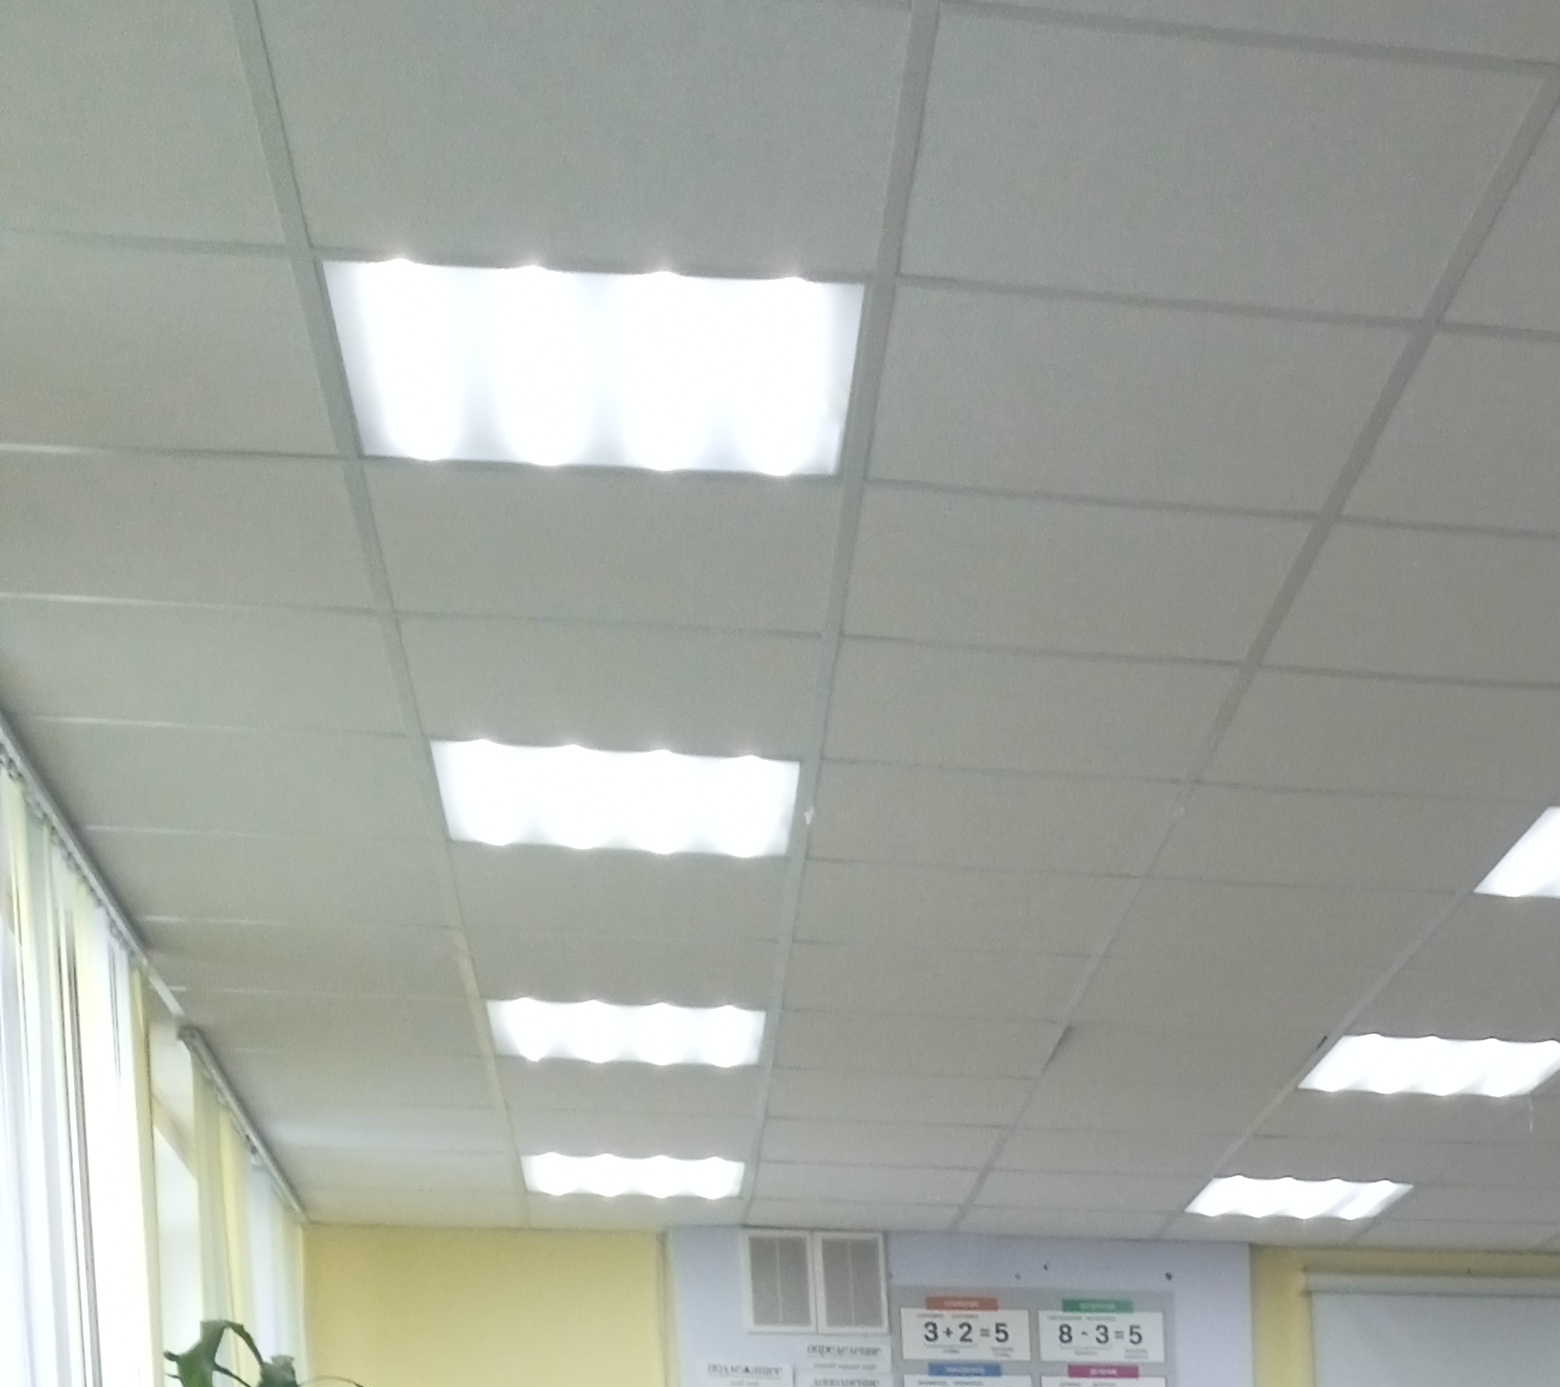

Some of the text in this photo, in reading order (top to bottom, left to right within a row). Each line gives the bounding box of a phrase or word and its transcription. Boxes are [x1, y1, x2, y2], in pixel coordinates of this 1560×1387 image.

[924, 1321, 939, 1342] 3
[958, 1321, 973, 1342] 2
[995, 1322, 1009, 1343] 5
[1059, 1323, 1073, 1344] 8
[1095, 1324, 1109, 1344] 3
[1129, 1325, 1143, 1345] 5
